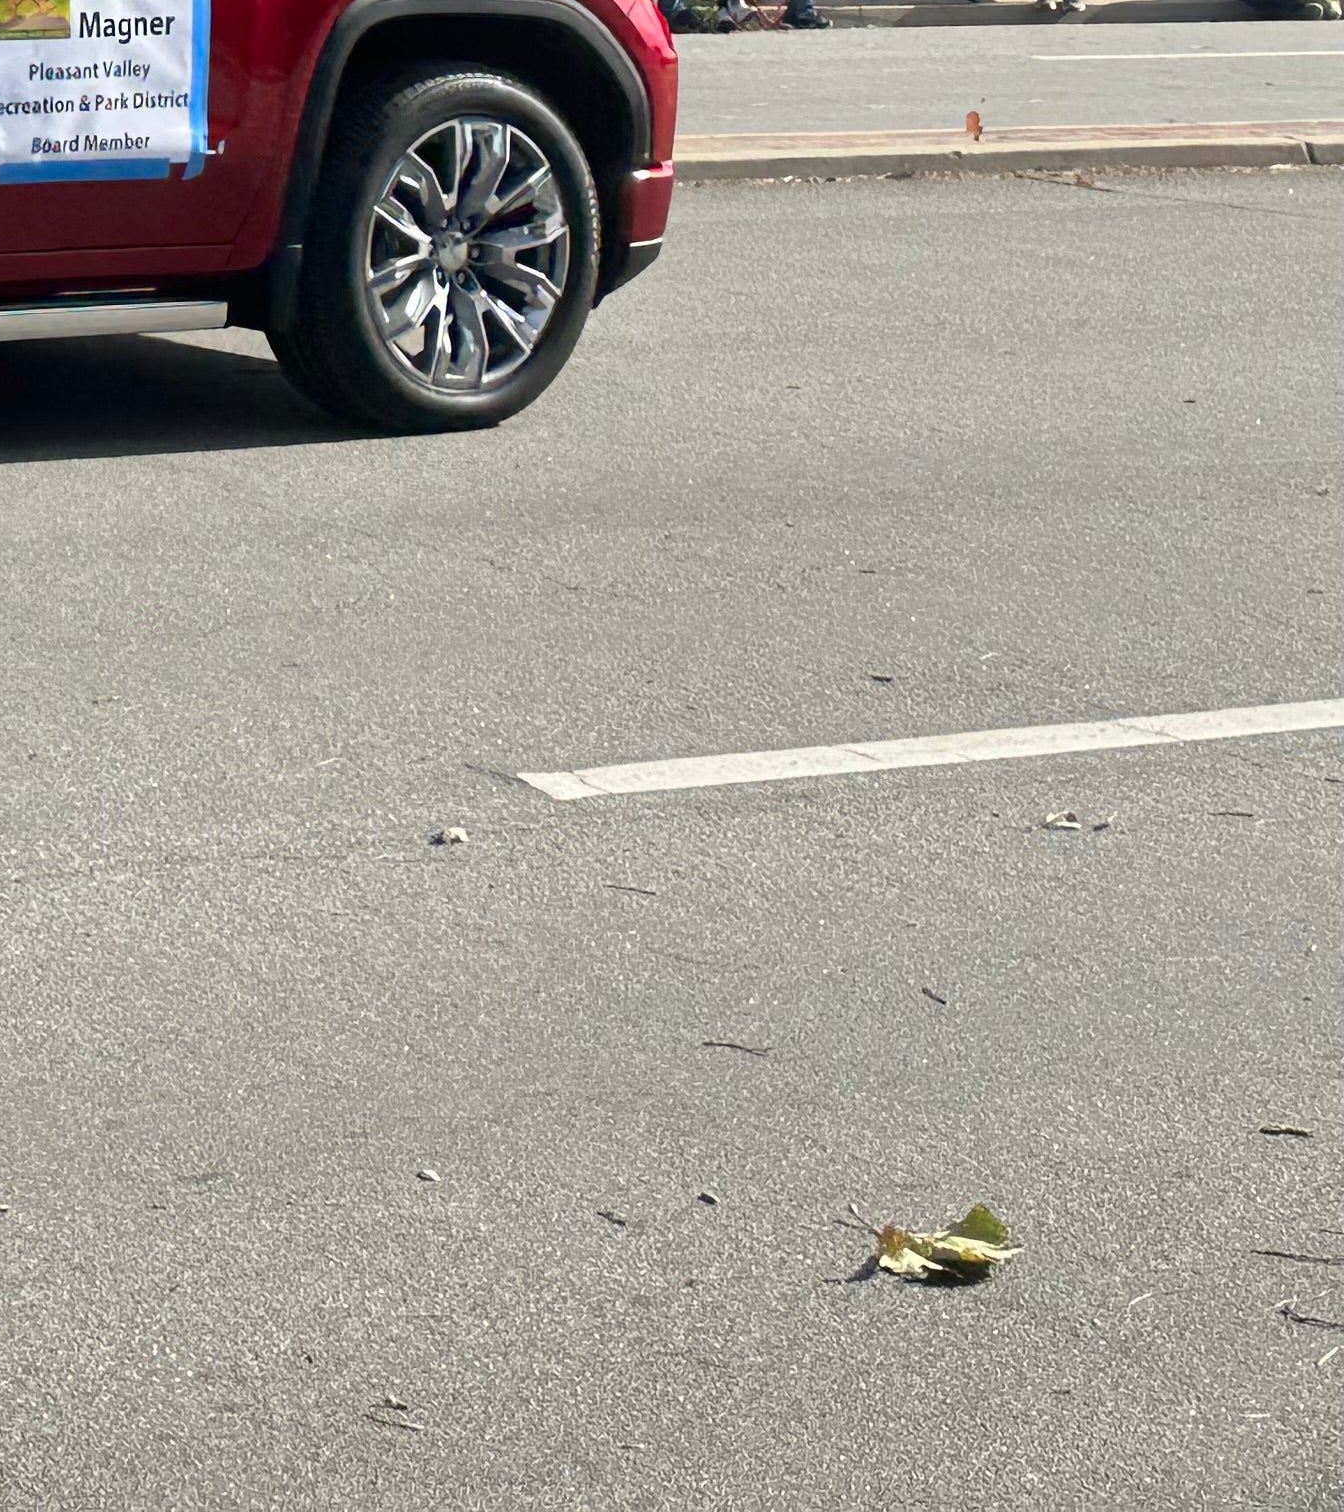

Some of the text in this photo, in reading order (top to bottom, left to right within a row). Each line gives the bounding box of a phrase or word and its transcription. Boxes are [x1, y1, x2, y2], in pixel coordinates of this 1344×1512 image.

[79, 11, 176, 44] Magner
[28, 61, 151, 82] Pleasant Valley
[79, 95, 91, 112] &
[95, 92, 129, 111] Park
[133, 90, 189, 108] District
[31, 132, 150, 155] Board Member
